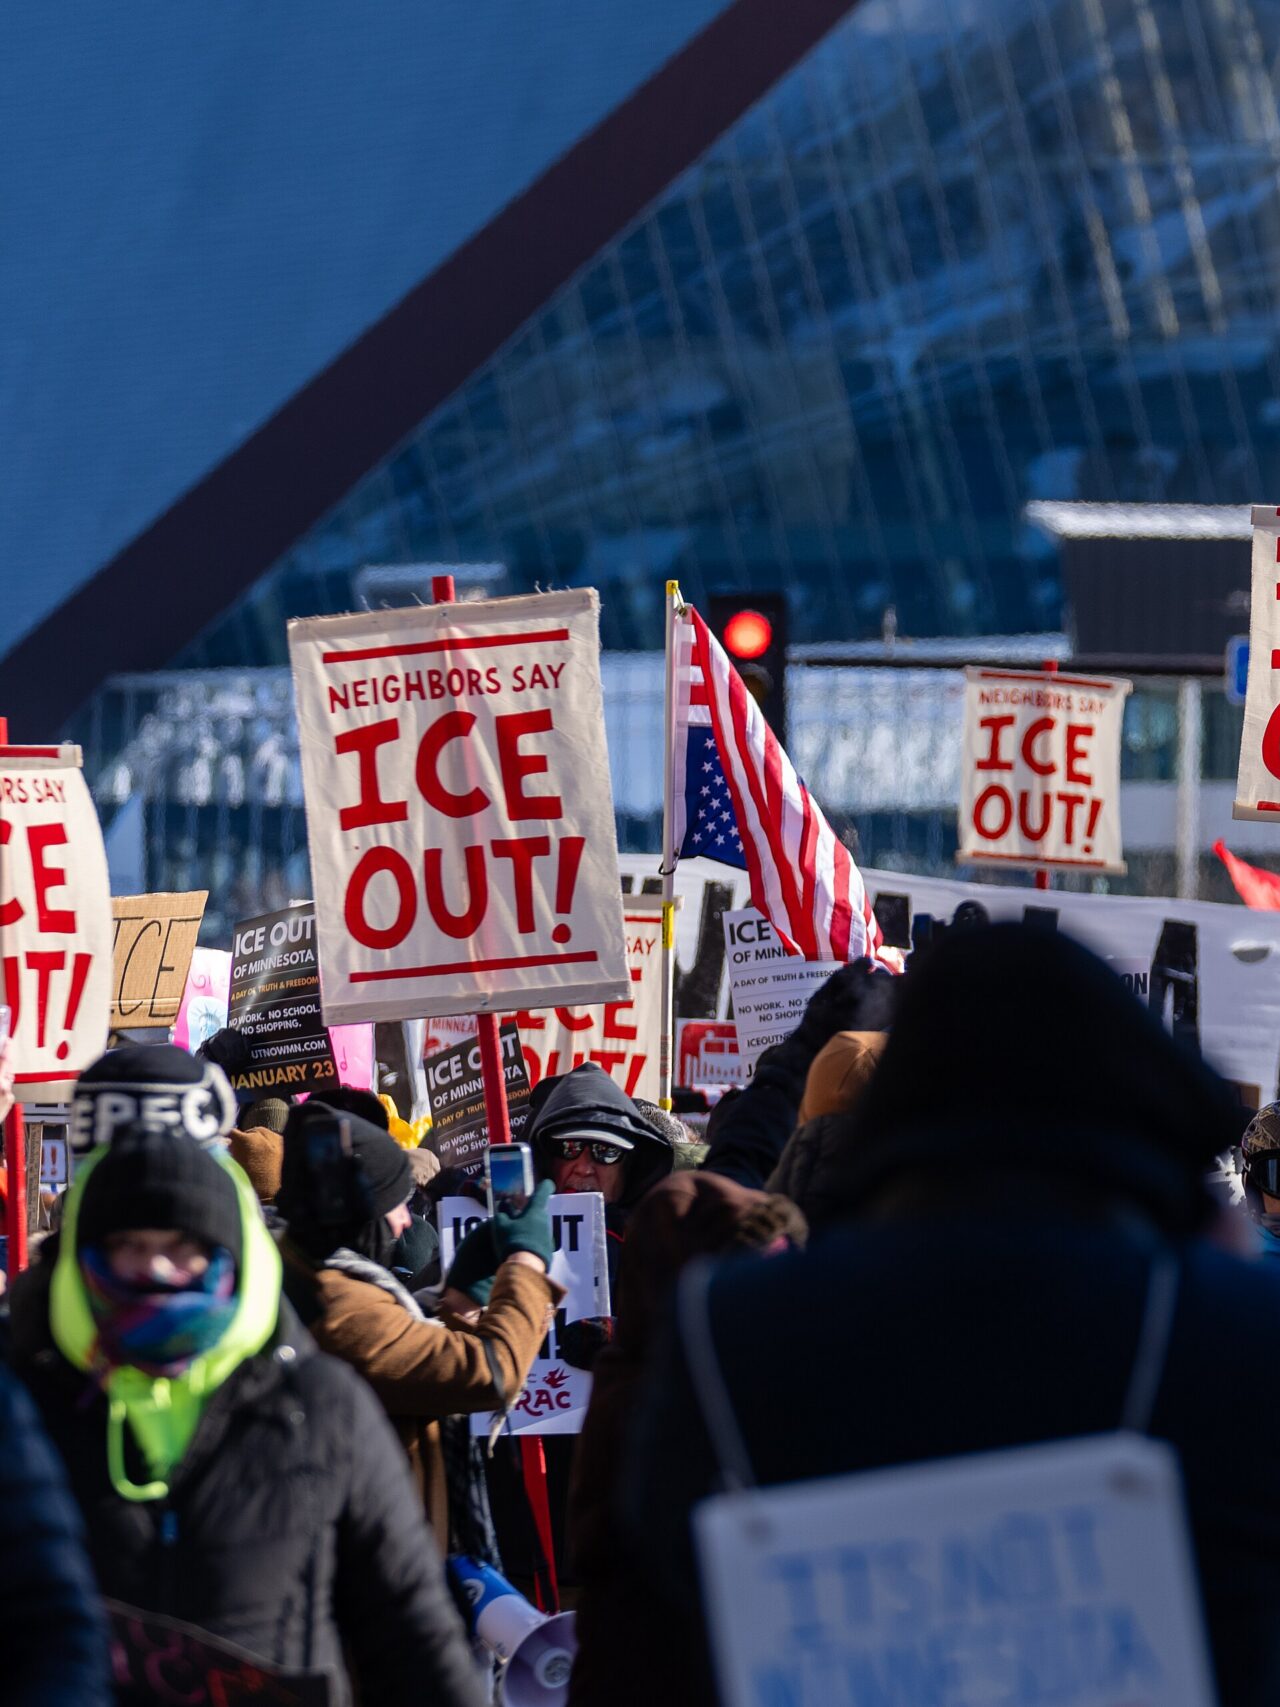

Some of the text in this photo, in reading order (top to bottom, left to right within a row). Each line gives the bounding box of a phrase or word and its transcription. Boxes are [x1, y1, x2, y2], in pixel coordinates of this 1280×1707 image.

[328, 662, 566, 713] NEIGHBORS SAY
[976, 715, 1094, 786] ICE
[335, 708, 563, 831] ICE
[33, 777, 66, 804] SAY
[972, 784, 1103, 854] OUT!
[344, 836, 585, 950] OUT!
[235, 914, 317, 958] ICE OUT
[728, 919, 771, 945] ICE
[234, 949, 315, 979] OF MINNESOTA
[733, 951, 752, 964] OF
[258, 981, 278, 994] TRUTH
[279, 982, 285, 990] &
[285, 976, 318, 989] FREEDOM
[741, 978, 756, 988] DAY
[758, 977, 769, 985] OF
[772, 973, 797, 983] TRUTH
[239, 1012, 265, 1024] WORK.
[268, 1009, 281, 1019] NO
[283, 1003, 320, 1017] SCHOOL.
[738, 1005, 752, 1014] NO
[753, 1000, 785, 1012] WORK.
[788, 998, 802, 1008] NO
[759, 1012, 773, 1023] NO
[241, 1019, 302, 1036] NO SHOPPING.
[251, 1039, 326, 1059] UTNOWMN.COM
[428, 1032, 517, 1090] ICE OT
[312, 1060, 334, 1079] 23
[433, 1064, 523, 1108] OF MINNTA
[442, 1114, 454, 1125] DAY
[455, 1110, 465, 1118] OF
[440, 1142, 451, 1152] NO
[451, 1130, 479, 1147] WORK.
[456, 1145, 469, 1156] NO
[515, 1389, 572, 1416] RAC
